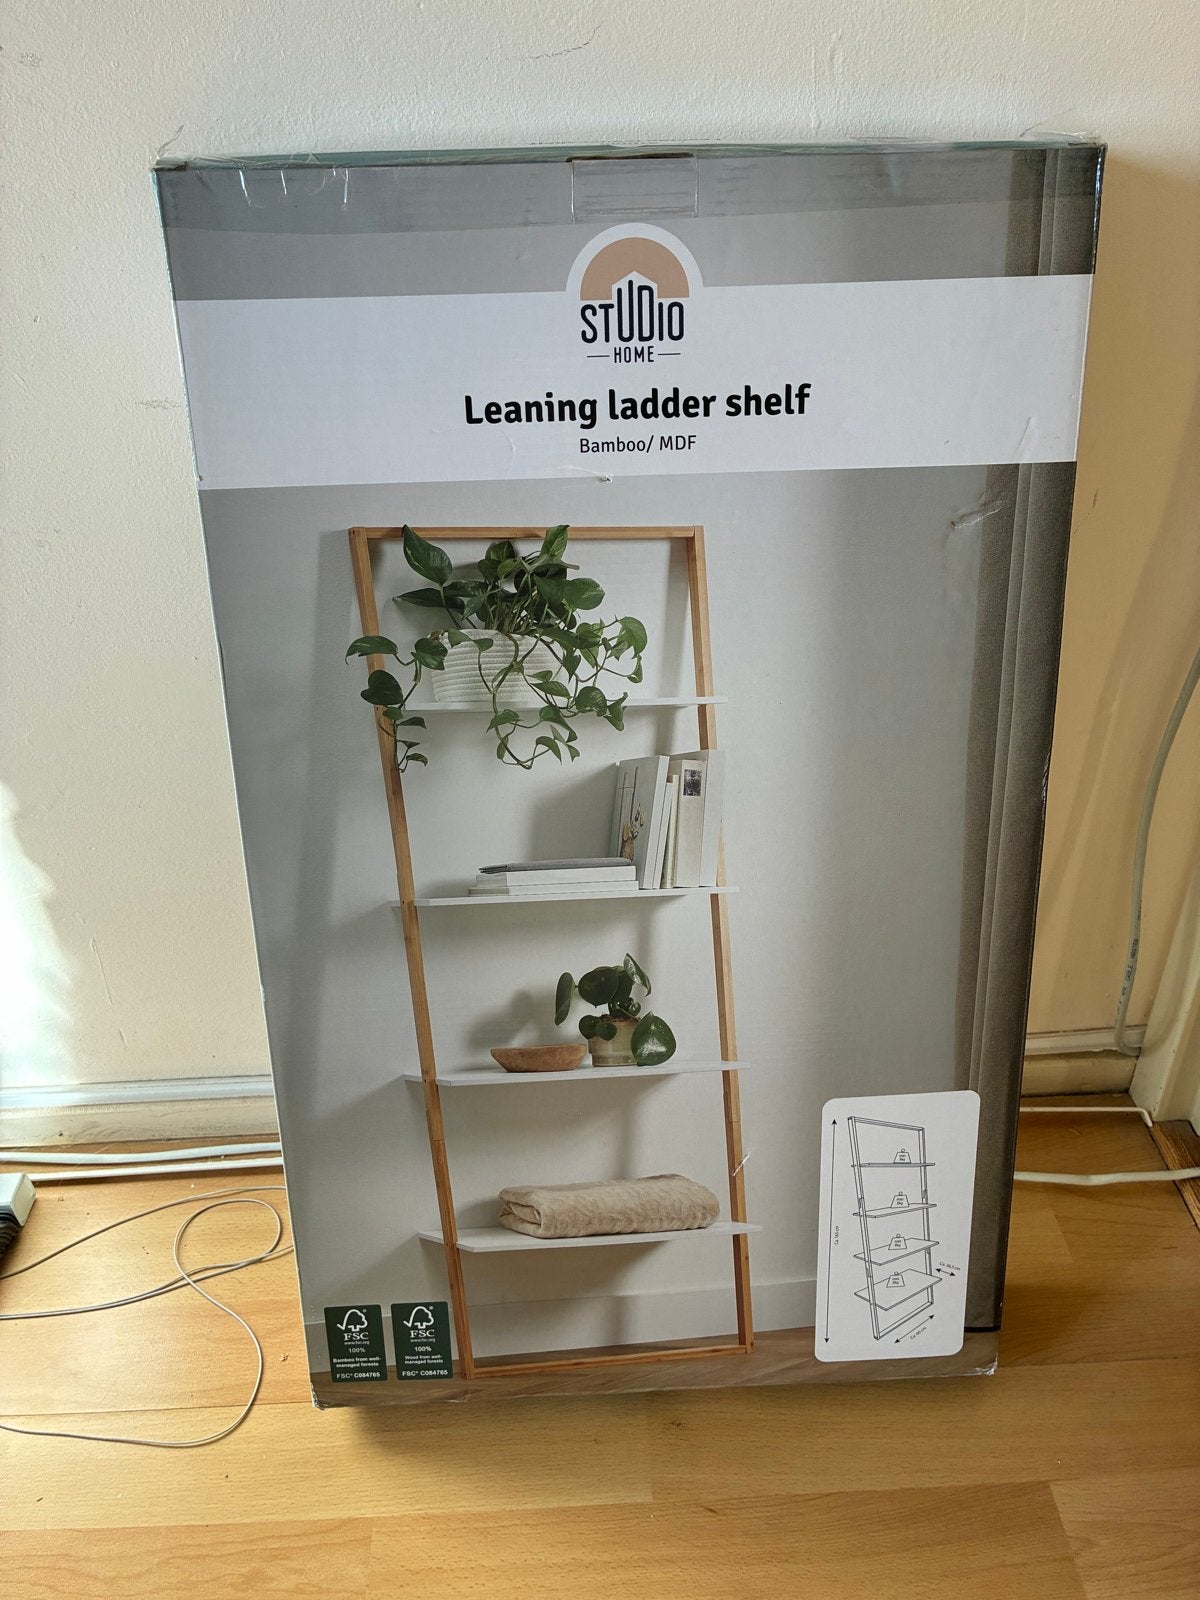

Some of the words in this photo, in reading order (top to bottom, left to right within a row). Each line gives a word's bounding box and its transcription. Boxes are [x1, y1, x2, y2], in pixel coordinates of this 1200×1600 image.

[581, 279, 685, 345] STUDIO
[613, 345, 655, 364] HOME
[465, 391, 597, 429] Leaning
[608, 387, 717, 420] ladder
[726, 383, 812, 417] shelf
[579, 435, 654, 455] Bamboo/
[659, 435, 697, 451] MDF
[344, 1332, 369, 1340] FSC
[410, 1330, 435, 1338] FSC
